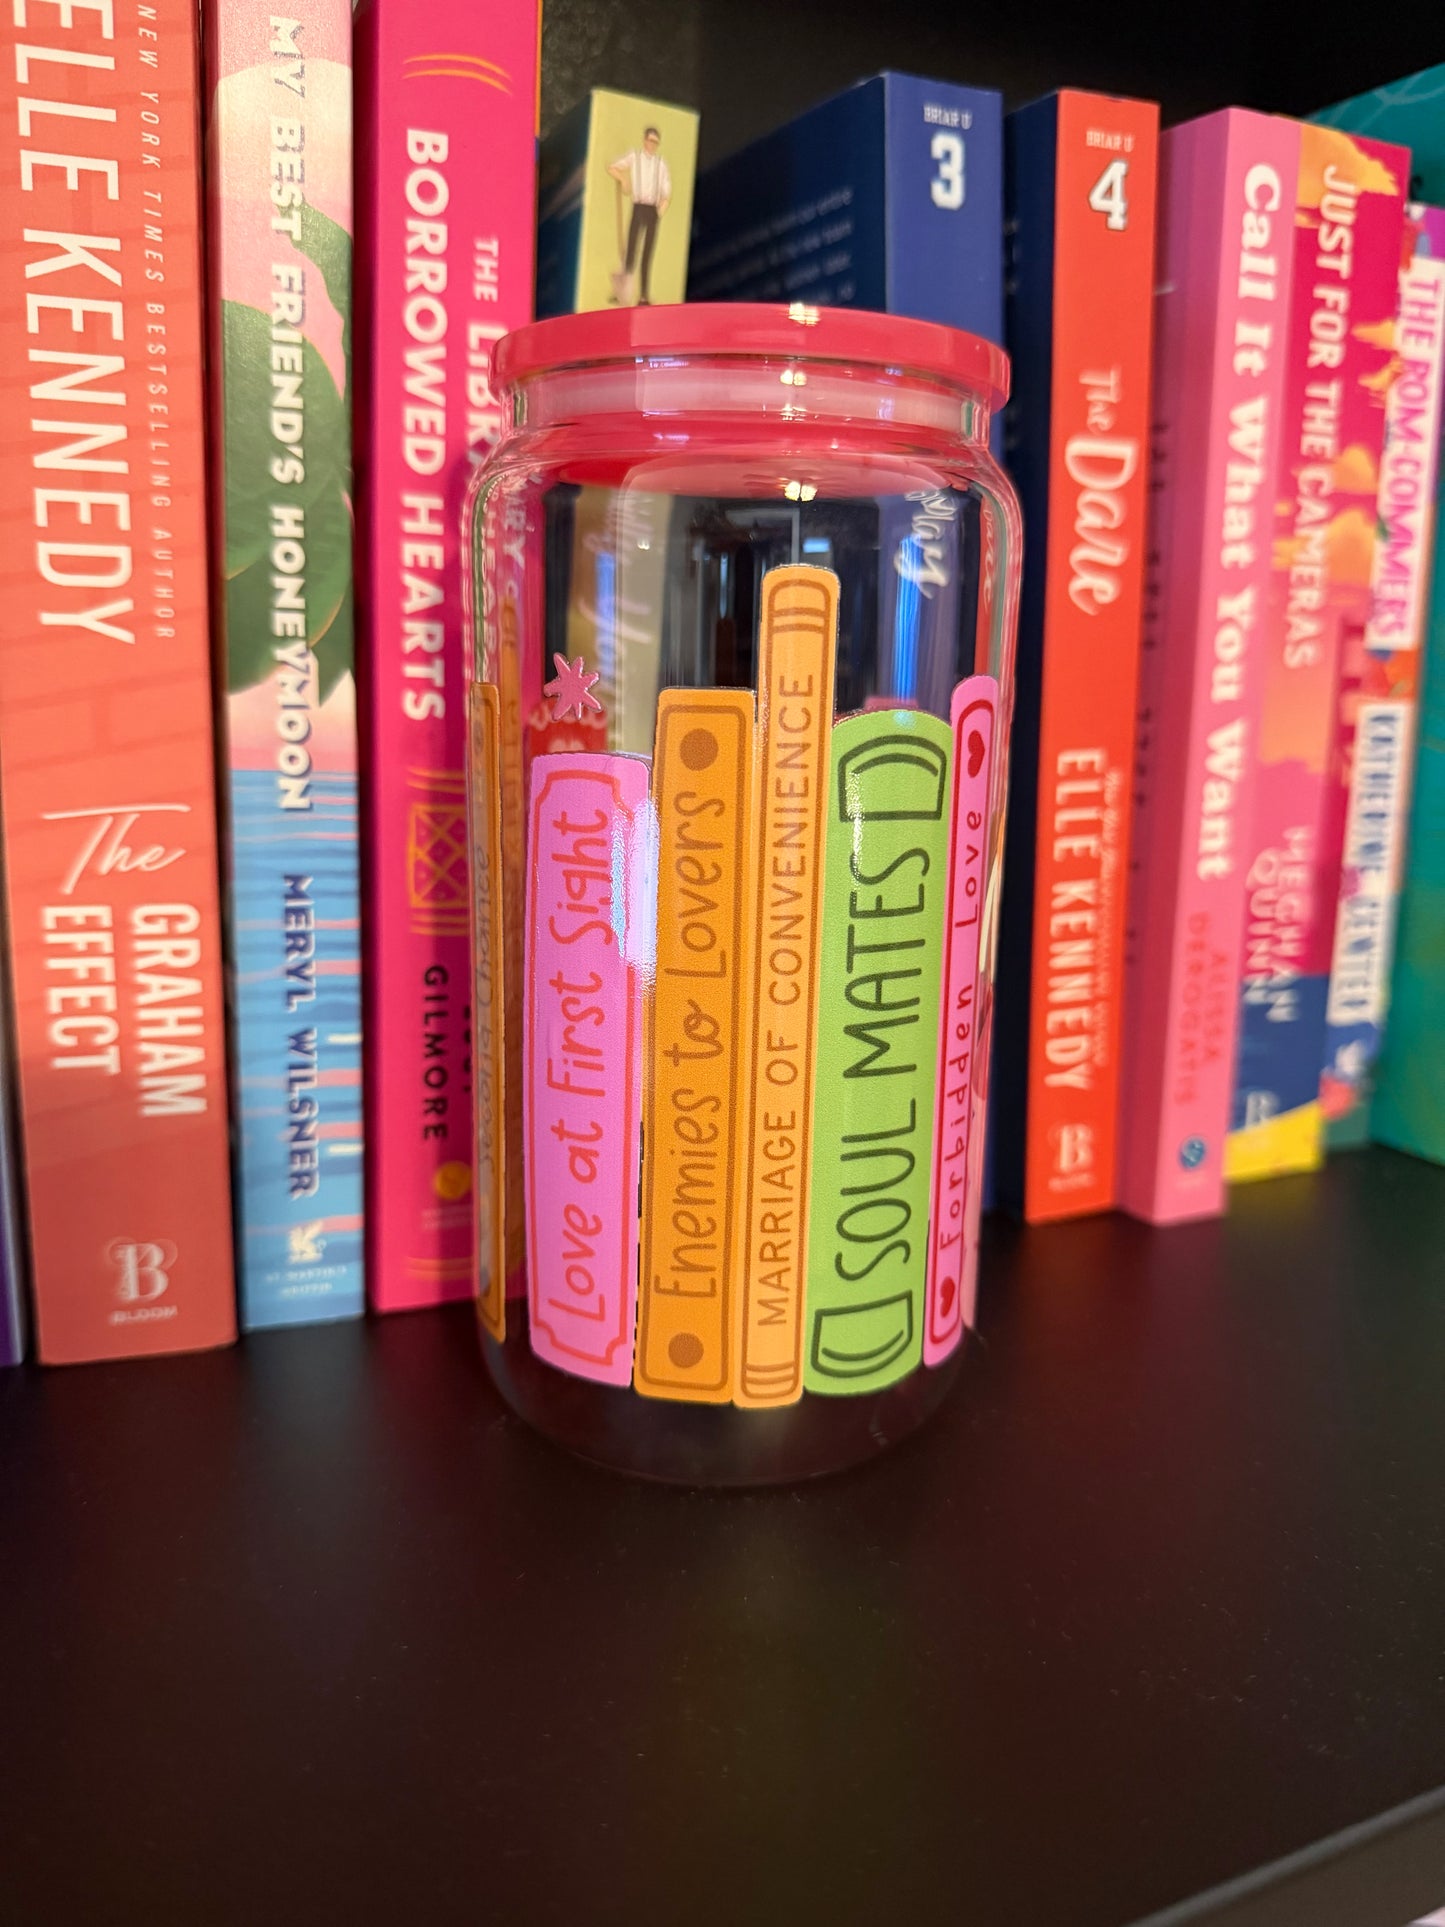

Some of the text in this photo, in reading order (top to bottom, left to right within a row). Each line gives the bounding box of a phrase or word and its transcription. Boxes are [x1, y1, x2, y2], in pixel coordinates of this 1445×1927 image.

[473, 236, 499, 302] THE
[930, 134, 966, 211] 3
[1086, 129, 1121, 151] BRIAR
[1088, 159, 1128, 231] 4
[12, 0, 135, 645] ELLE KENNEDY
[137, 4, 176, 639] NEW YORK TIMES BESTSELLING AUTHOR
[270, 15, 319, 811] MY BEST FRIEND'S HONEYMOON
[401, 128, 450, 722] BORROWED HEARTS
[1079, 369, 1122, 432] The
[1283, 165, 1357, 669] JUST FOR THE CAMERAS
[1369, 279, 1440, 638] THE ROM-COMMERS
[1064, 434, 1139, 616] Dare
[1197, 163, 1281, 881] Call It What You Want
[42, 804, 190, 895] The
[43, 904, 120, 1076] EFFECT
[131, 902, 207, 1118] GRAHAM
[758, 673, 814, 1327] MARRIAGE OF CONVENIENCE
[1044, 748, 1102, 1091] ELLE KENNEDY
[283, 873, 320, 1201] MERYL WILSNER
[423, 965, 449, 1140] GILMORE
[548, 807, 618, 1323] Love at First Sight
[653, 791, 726, 1300] Enemies to Lovers
[834, 849, 930, 1282] SOUL MATES
[939, 811, 982, 1251] Forbidden Love
